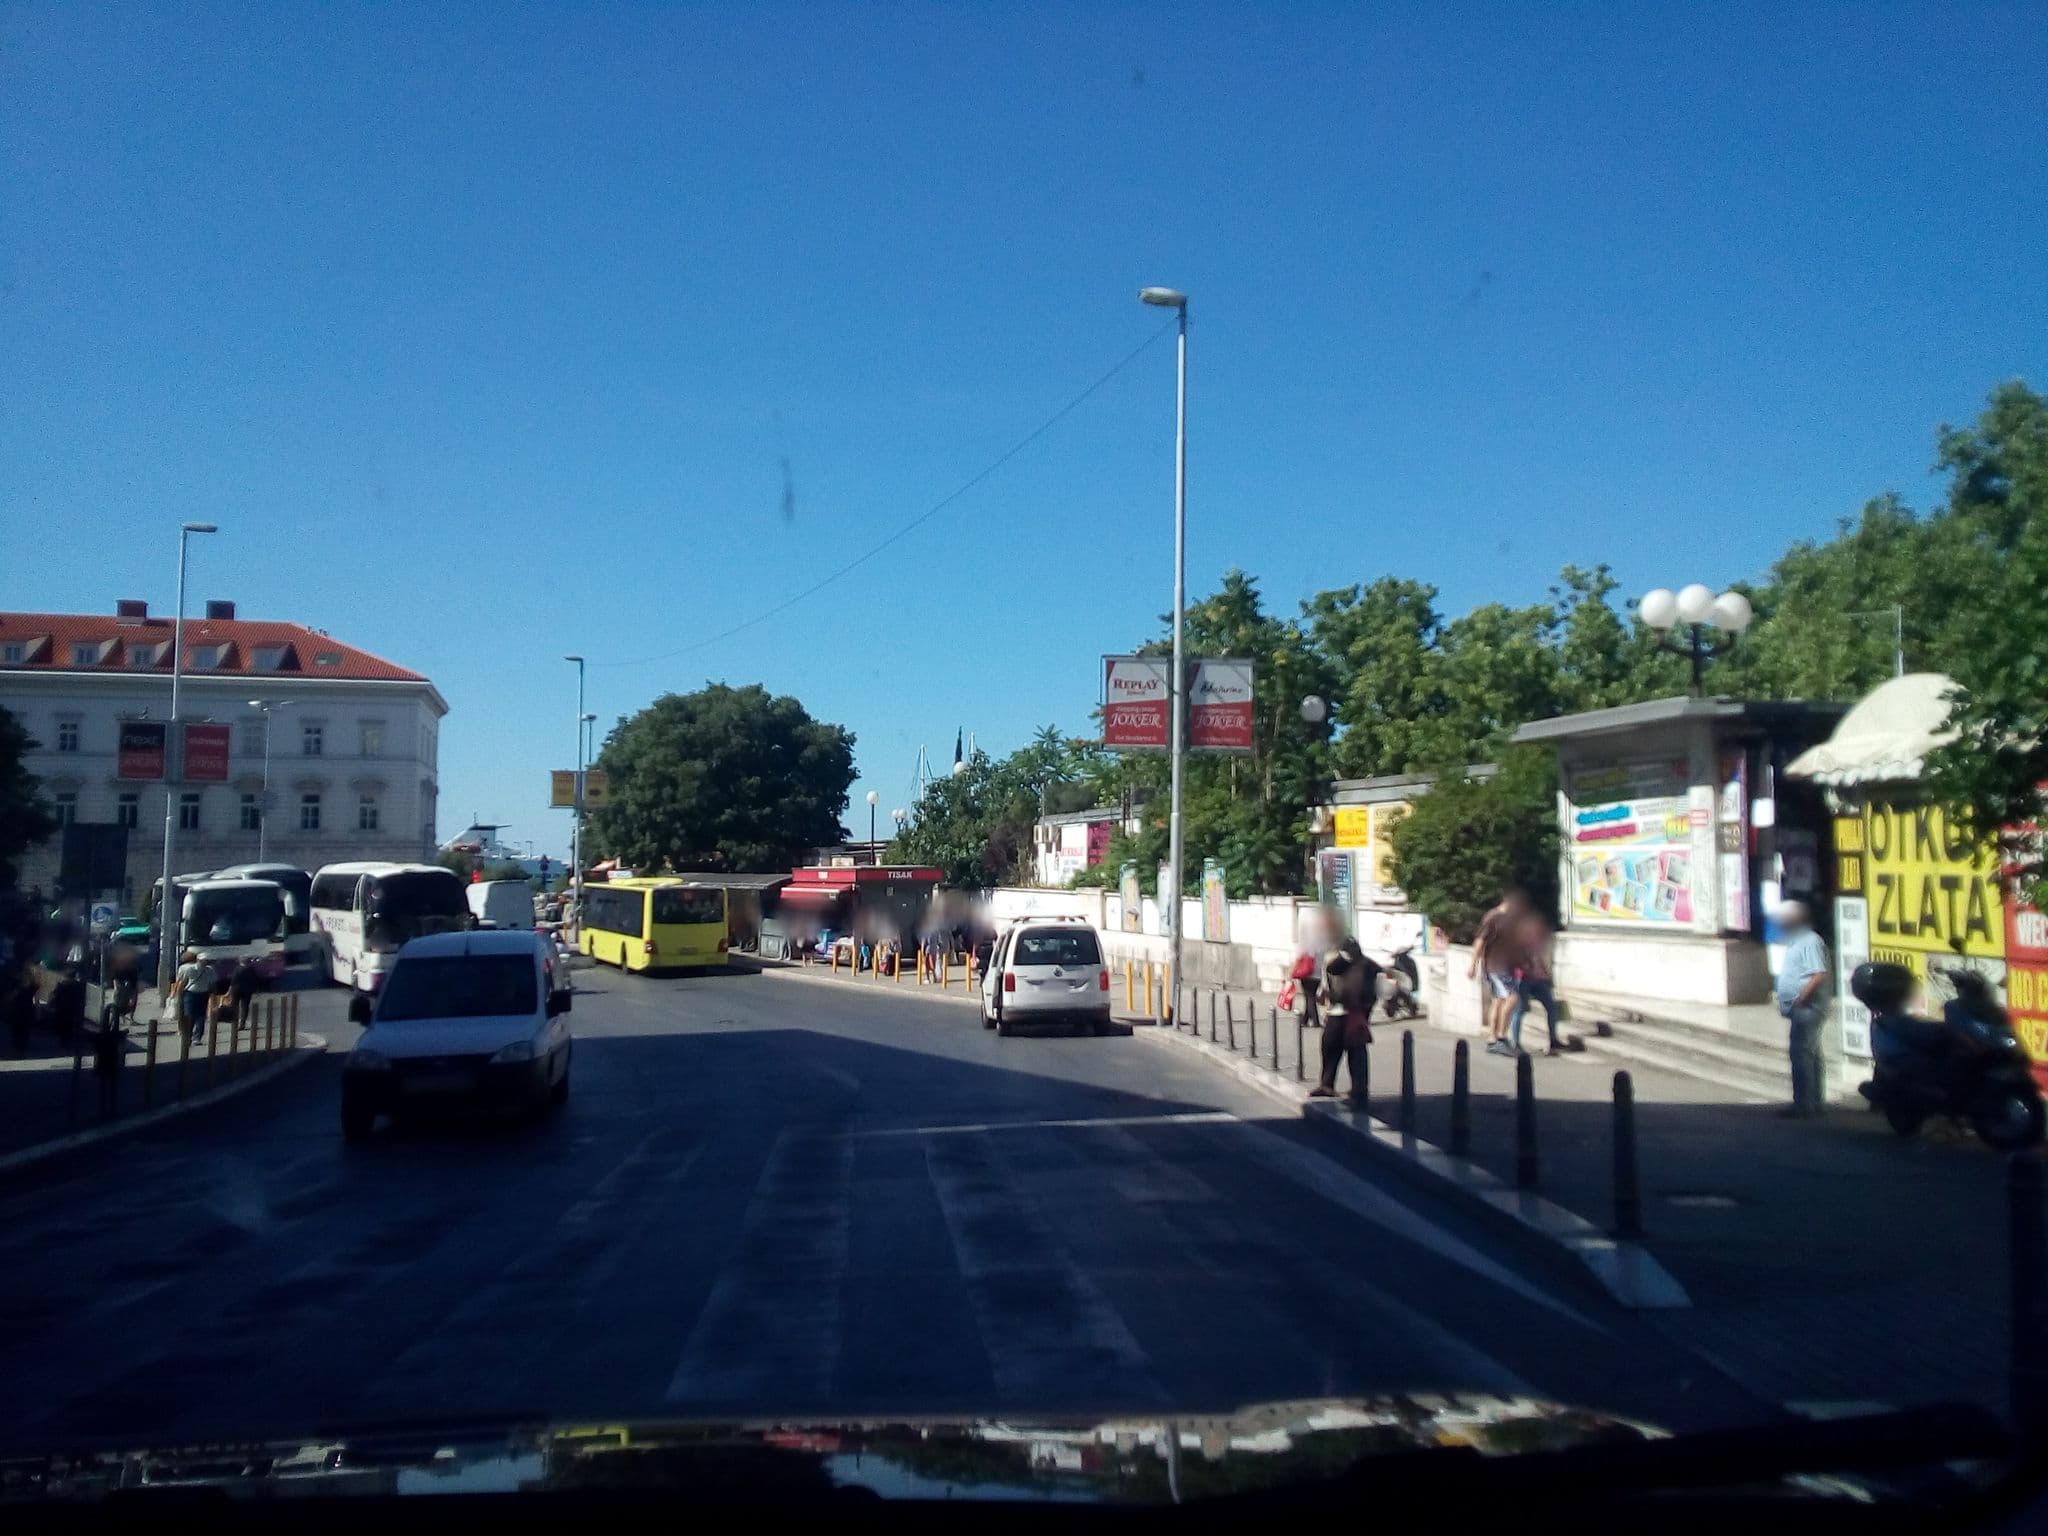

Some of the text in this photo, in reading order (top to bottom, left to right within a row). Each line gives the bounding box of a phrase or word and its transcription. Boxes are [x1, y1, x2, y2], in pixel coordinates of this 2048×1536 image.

[1113, 679, 1158, 690] REPLAY
[1109, 712, 1162, 728] JOKER
[1869, 804, 1988, 868] OTKU
[887, 871, 914, 879] TISAK
[1877, 872, 1995, 945] ZLATA
